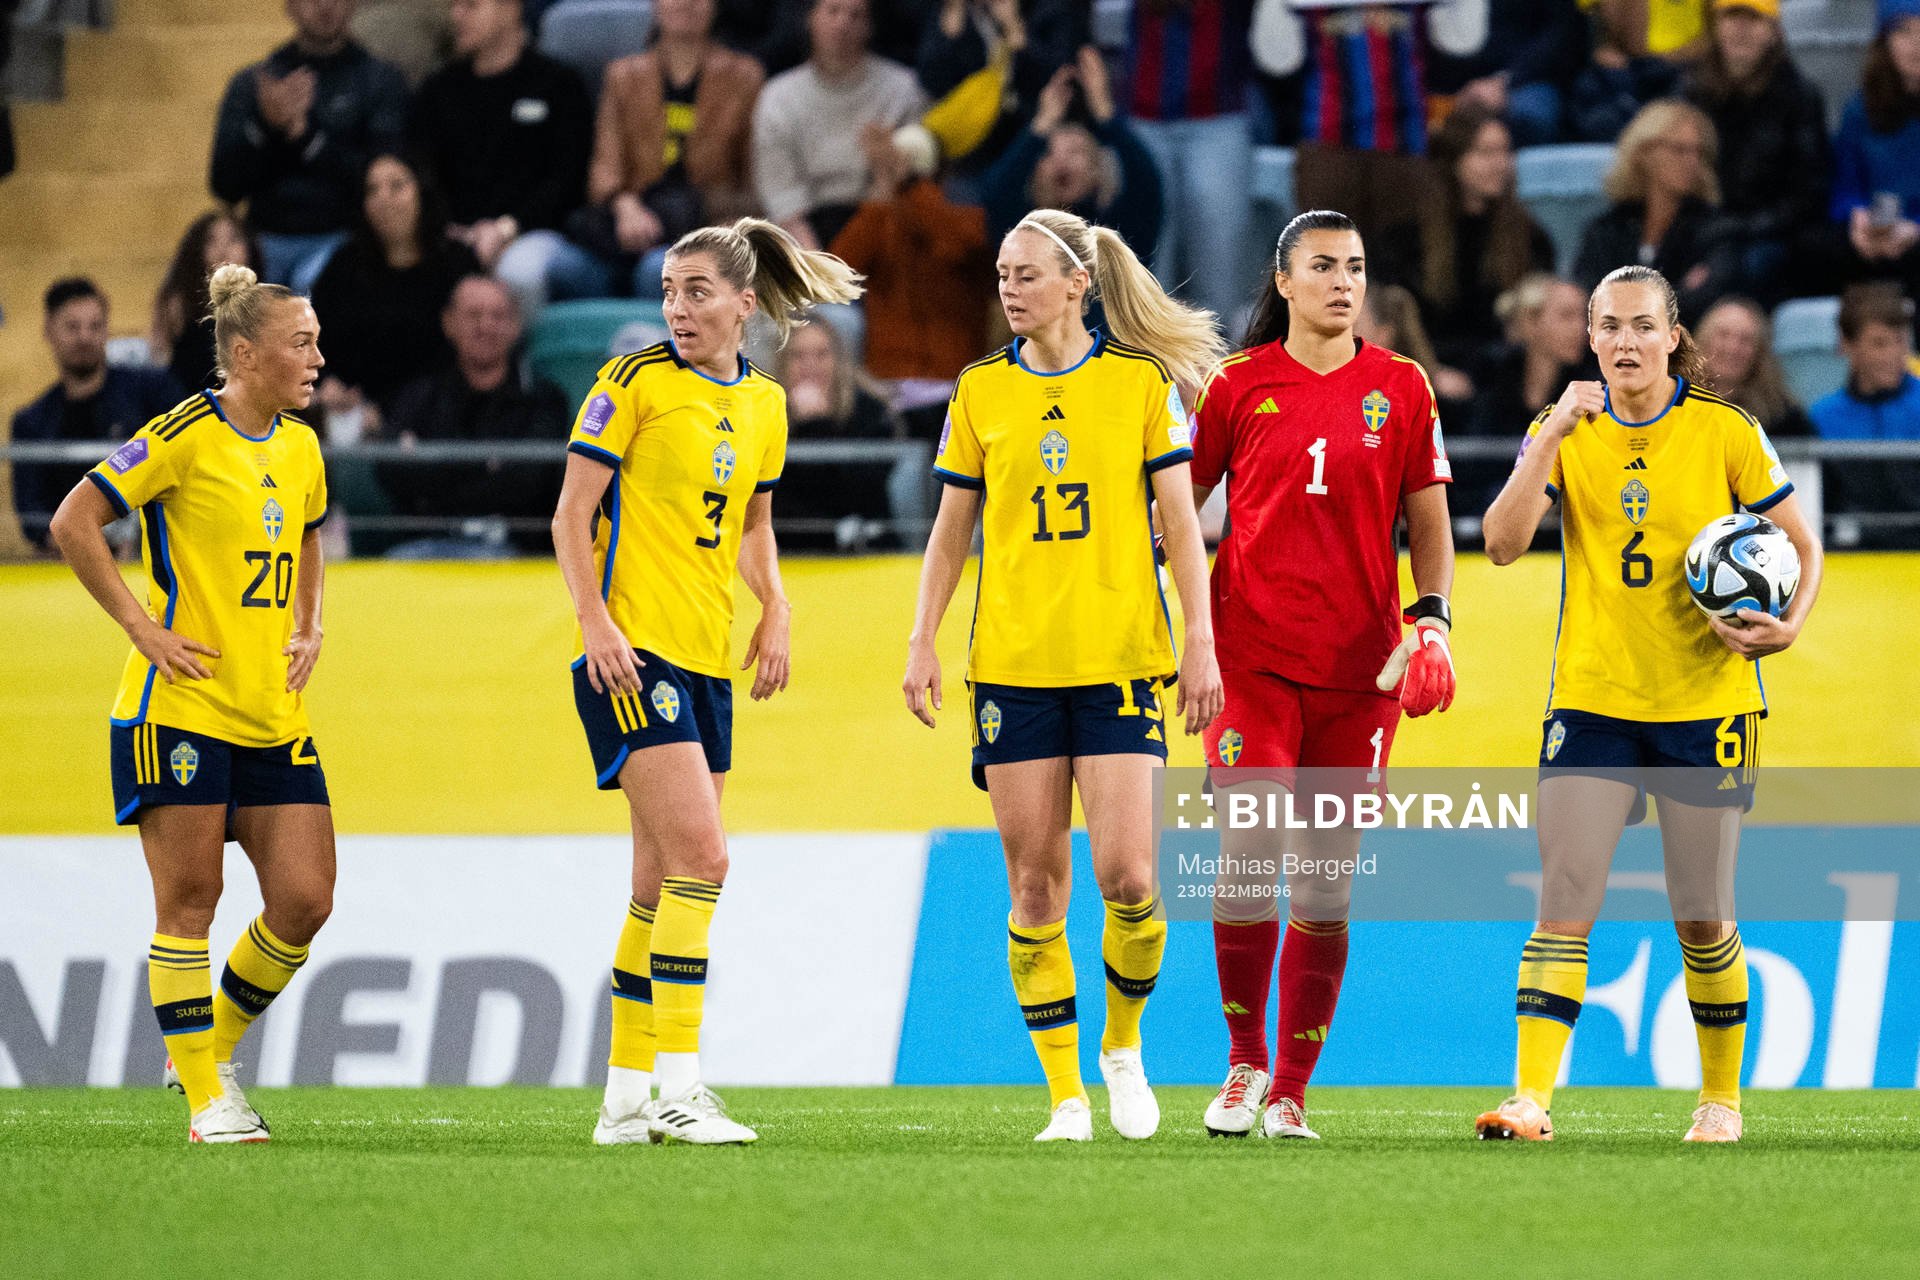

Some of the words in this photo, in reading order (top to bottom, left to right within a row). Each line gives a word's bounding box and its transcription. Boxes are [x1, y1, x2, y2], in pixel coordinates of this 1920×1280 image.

[1305, 437, 1329, 496] 1
[694, 490, 728, 550] 3
[1030, 482, 1092, 543] 13
[241, 550, 294, 608] 20
[1620, 530, 1653, 588] 6
[1366, 727, 1384, 783] 1
[1715, 716, 1743, 768] 6
[652, 960, 705, 974] SVERIGE
[1506, 870, 1920, 1089] Fol
